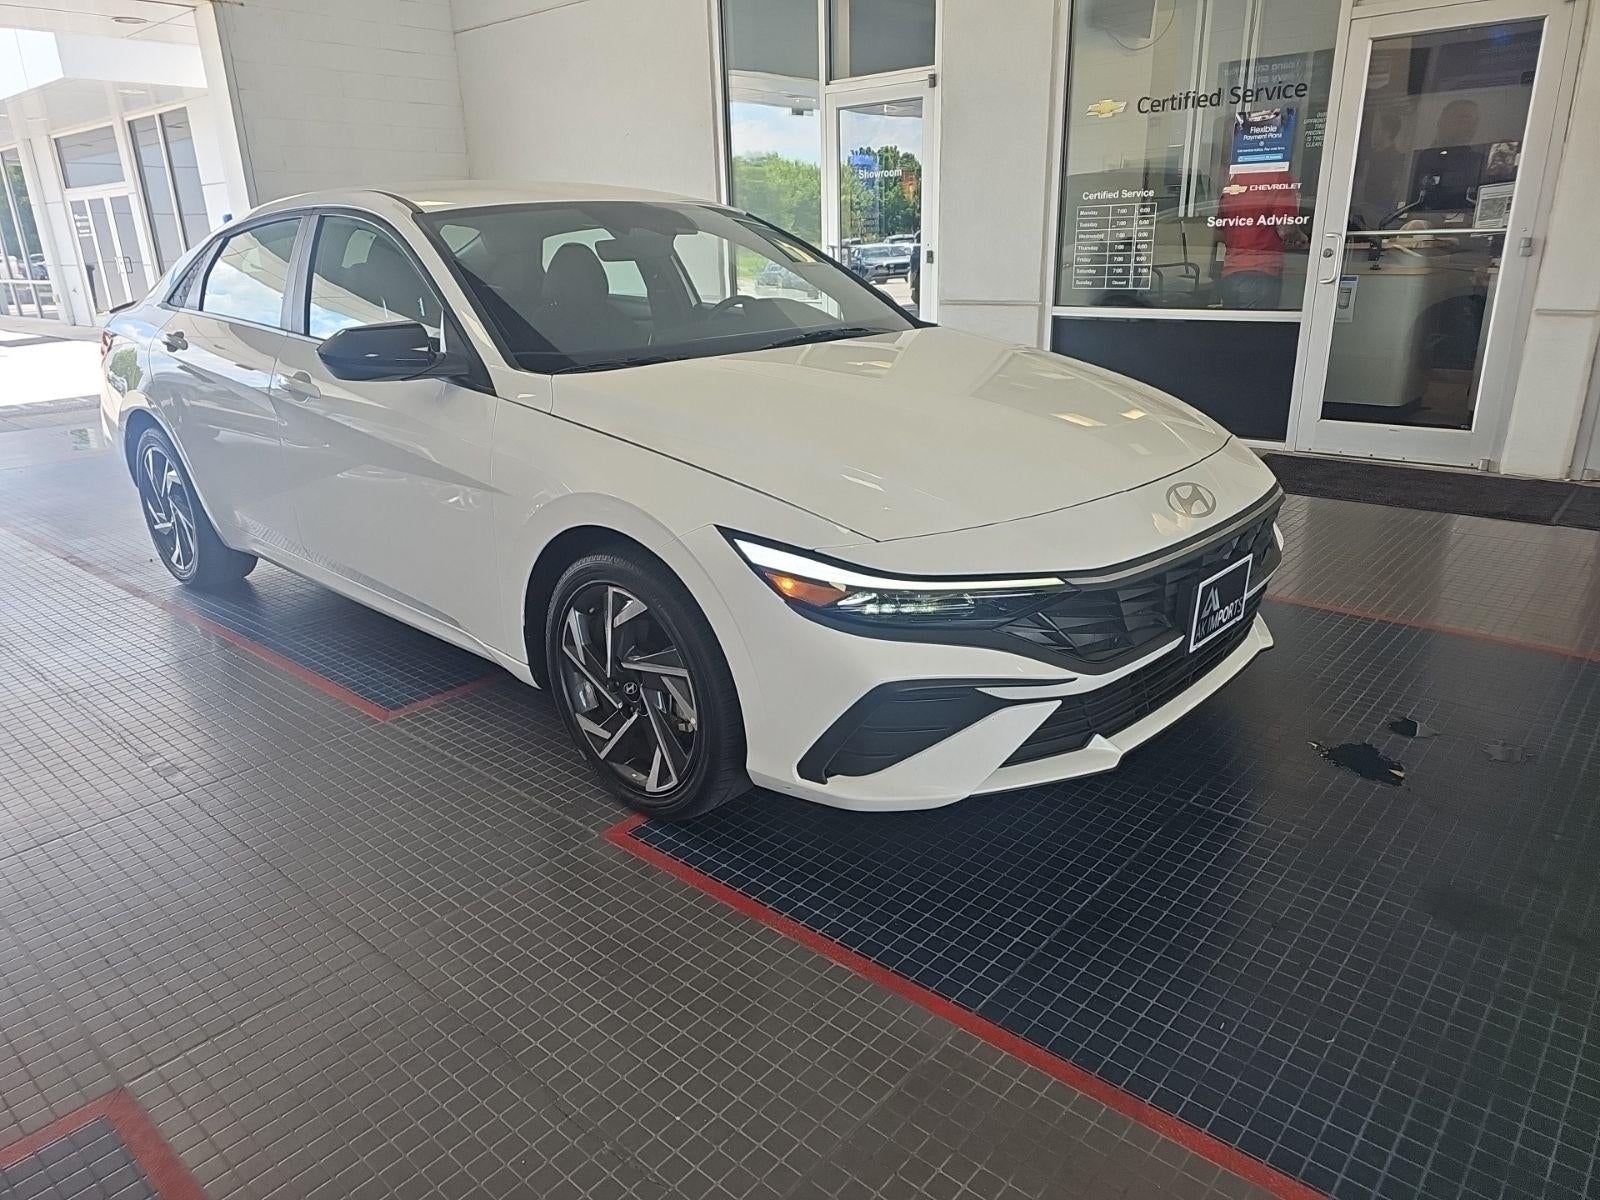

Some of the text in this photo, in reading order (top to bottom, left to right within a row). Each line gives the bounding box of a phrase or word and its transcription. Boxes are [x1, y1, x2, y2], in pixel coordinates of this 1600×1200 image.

[1137, 80, 1308, 114] Certified Service
[1250, 125, 1277, 133] Flexible
[1243, 133, 1267, 141] Payment
[859, 169, 902, 179] Showroom
[1250, 182, 1302, 191] CHEVROLET
[1082, 188, 1154, 200] Certified Service
[1207, 214, 1310, 227] Service Advisor
[1207, 597, 1242, 633] IMPORTS
